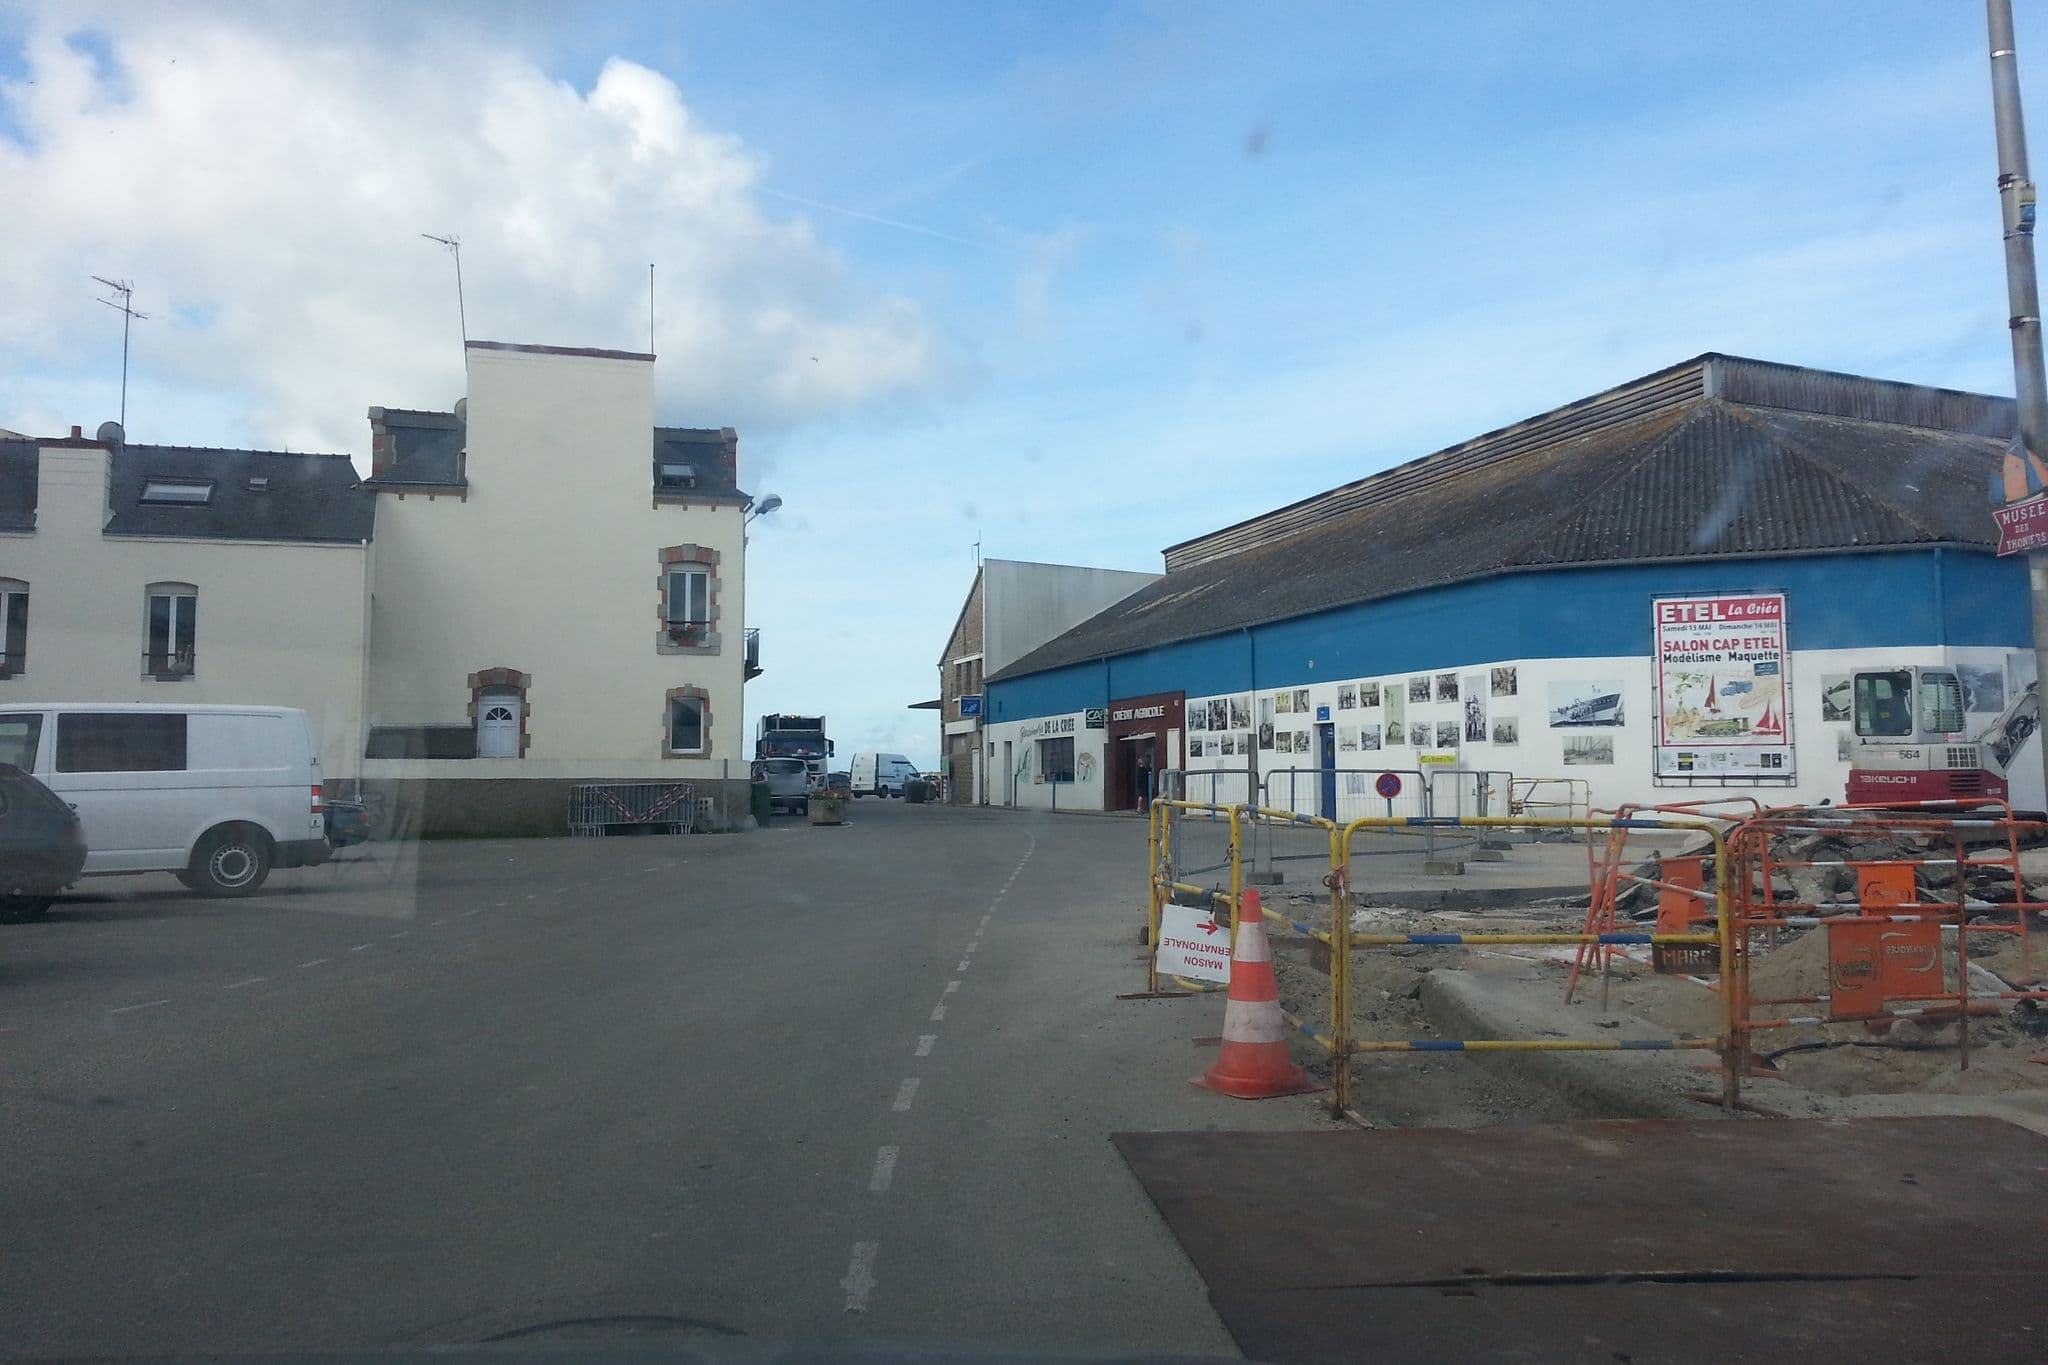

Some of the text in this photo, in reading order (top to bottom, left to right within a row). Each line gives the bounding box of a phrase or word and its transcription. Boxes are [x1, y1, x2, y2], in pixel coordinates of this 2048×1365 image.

[2015, 523, 2029, 533] DES
[2006, 532, 2047, 550] THONIERS
[1661, 601, 1779, 623] ETEL La Criée
[1662, 624, 1688, 633] Samedi
[1719, 623, 1752, 631] Dimanche
[1663, 637, 1779, 653] SALON CAP ETEL
[1663, 650, 1780, 664] Modélisme Maquette
[1134, 705, 1165, 719] AGRICOLE
[1860, 775, 1917, 784] TAKEUCHI
[1163, 937, 1232, 956] ERNATIONALE
[1184, 955, 1223, 970] MAISON
